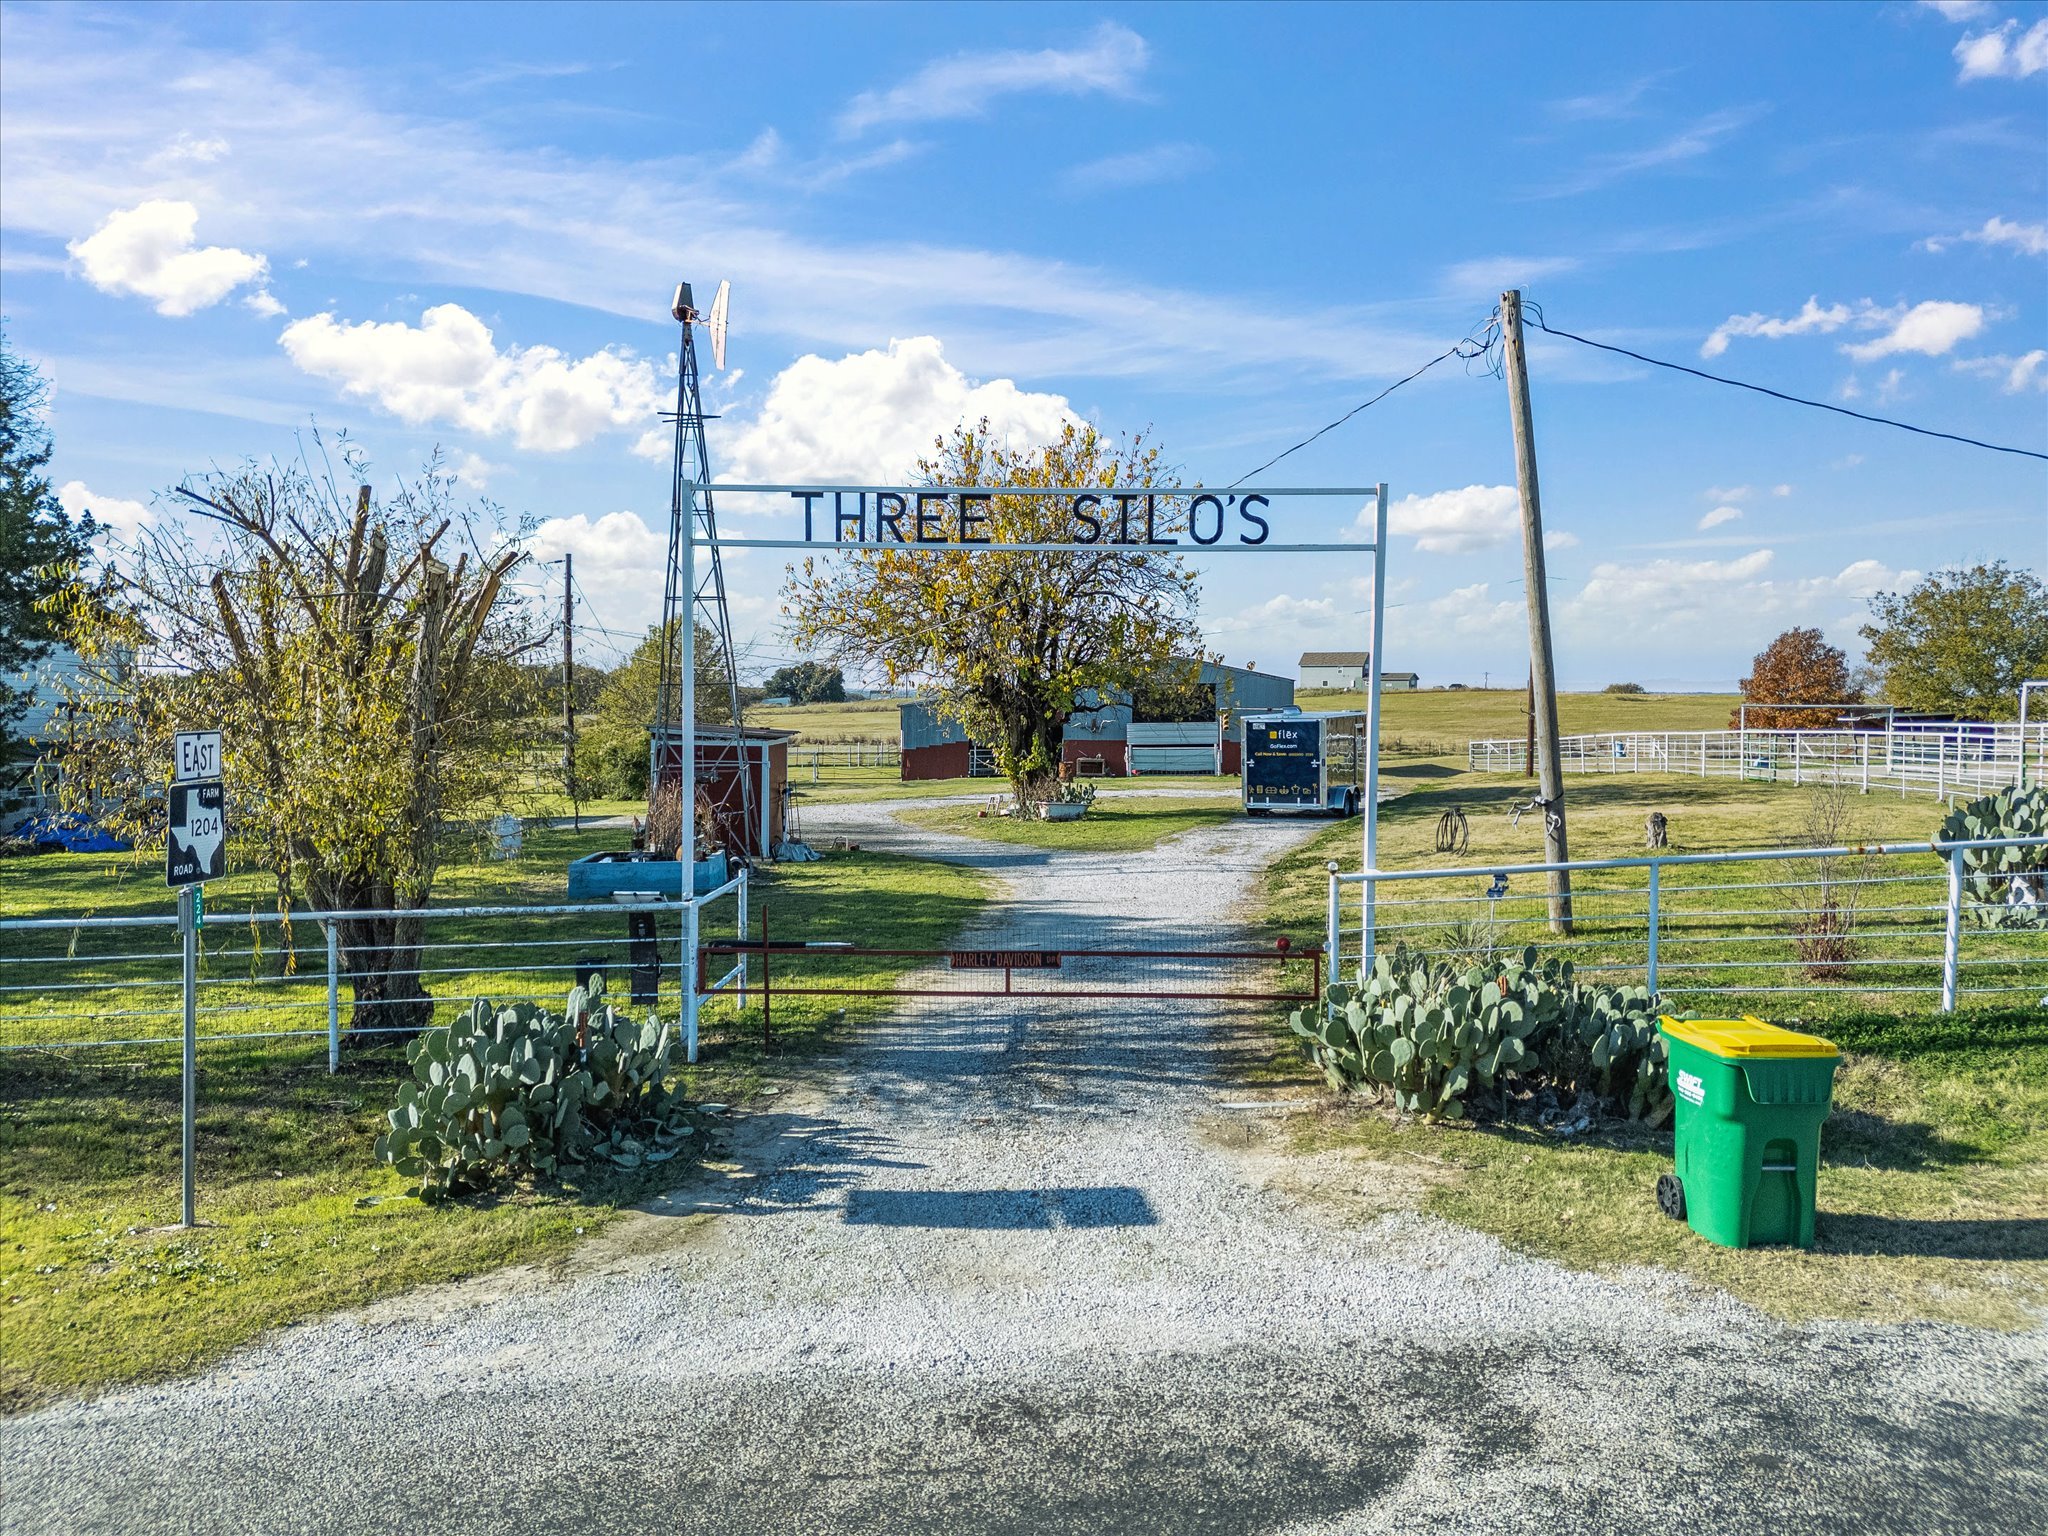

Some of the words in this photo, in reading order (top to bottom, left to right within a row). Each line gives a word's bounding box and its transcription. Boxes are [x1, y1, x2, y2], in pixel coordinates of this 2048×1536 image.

[791, 492, 991, 544] THREE
[1073, 494, 1270, 546] SILO'S
[183, 742, 214, 773] EAST
[202, 788, 220, 799] FARM
[190, 817, 218, 837] 1204
[173, 864, 193, 877] ROAD
